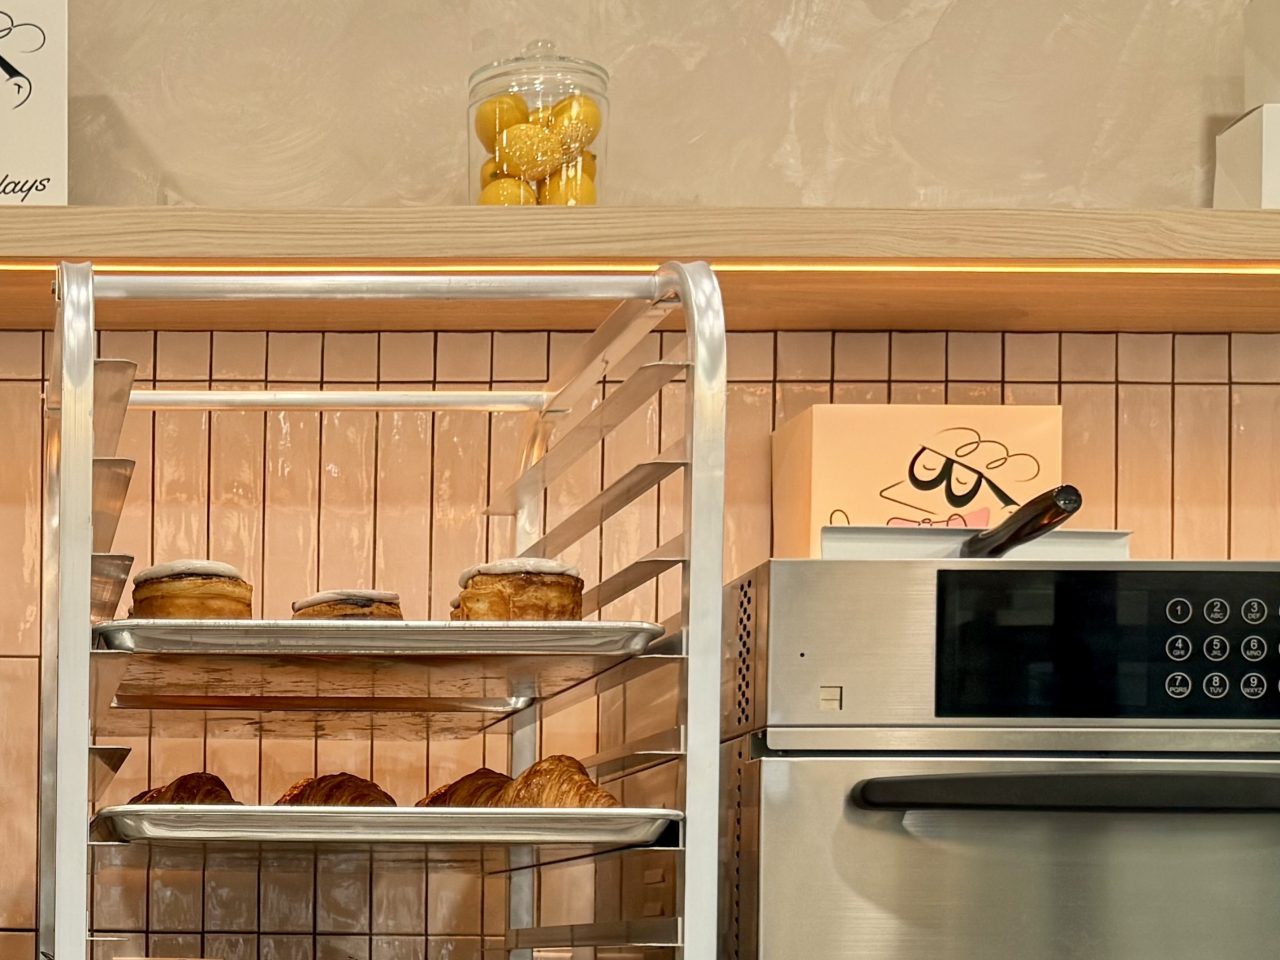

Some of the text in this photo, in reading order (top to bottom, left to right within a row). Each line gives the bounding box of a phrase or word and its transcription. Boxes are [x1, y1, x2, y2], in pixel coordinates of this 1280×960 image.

[1176, 605, 1182, 616] 1
[1213, 601, 1221, 613] 2
[1250, 602, 1258, 613] 3
[1175, 639, 1183, 649] 4
[1212, 639, 1221, 650] 5
[1250, 639, 1258, 650] 6
[1174, 676, 1183, 687] 7
[1212, 676, 1220, 687] 8
[1250, 676, 1258, 688] 9
